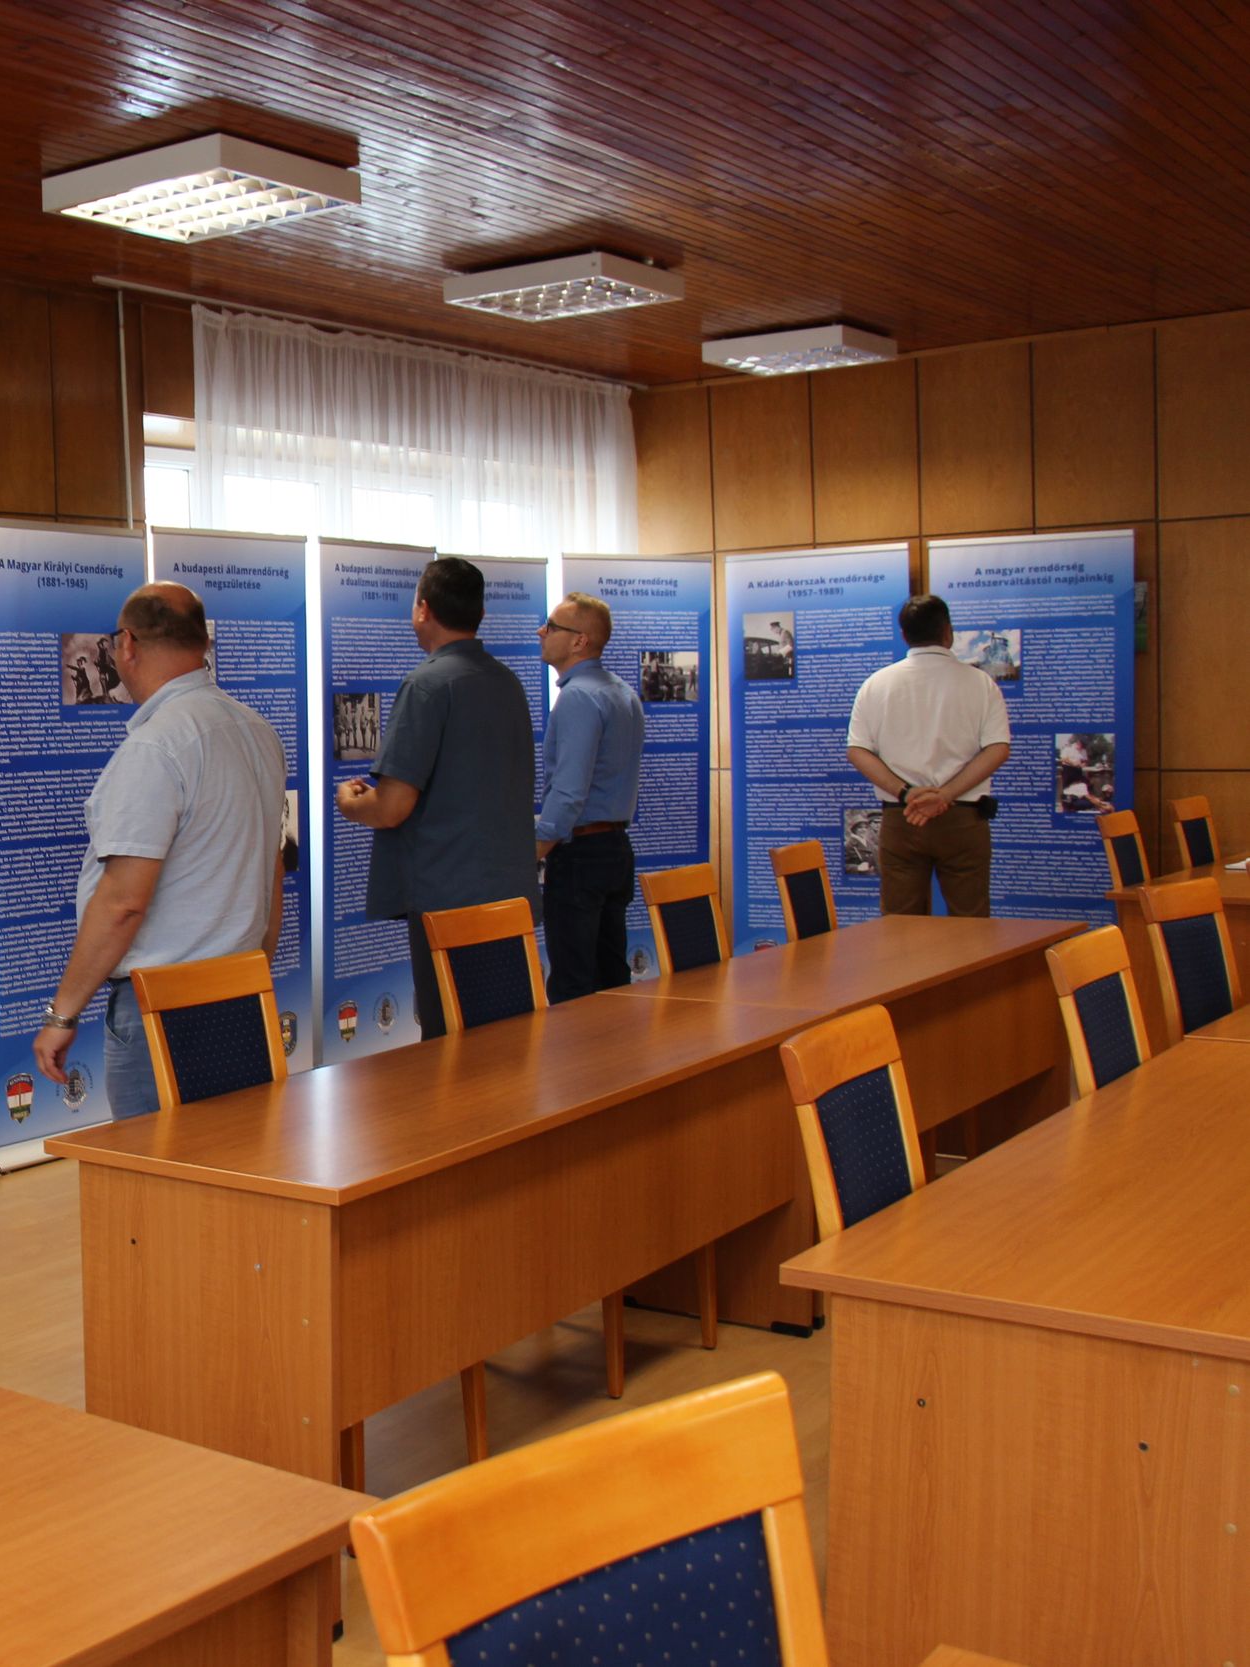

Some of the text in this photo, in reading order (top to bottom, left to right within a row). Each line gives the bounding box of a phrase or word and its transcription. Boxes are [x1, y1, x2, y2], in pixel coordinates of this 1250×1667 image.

[0, 559, 124, 578] A Magyar Királyi Csendőrség
[174, 562, 289, 579] A budapesti államrendőrség
[984, 568, 1026, 577] magyar
[1028, 563, 1086, 574] rendőrség
[205, 578, 261, 592] megszületése
[606, 579, 636, 588] magyar
[638, 578, 679, 588] rendőrség
[756, 577, 826, 588] Kádár-korszak
[828, 575, 886, 584] rendőrsége
[956, 577, 1051, 588] rendszerváltástól
[1054, 575, 1114, 586] napjainkig
